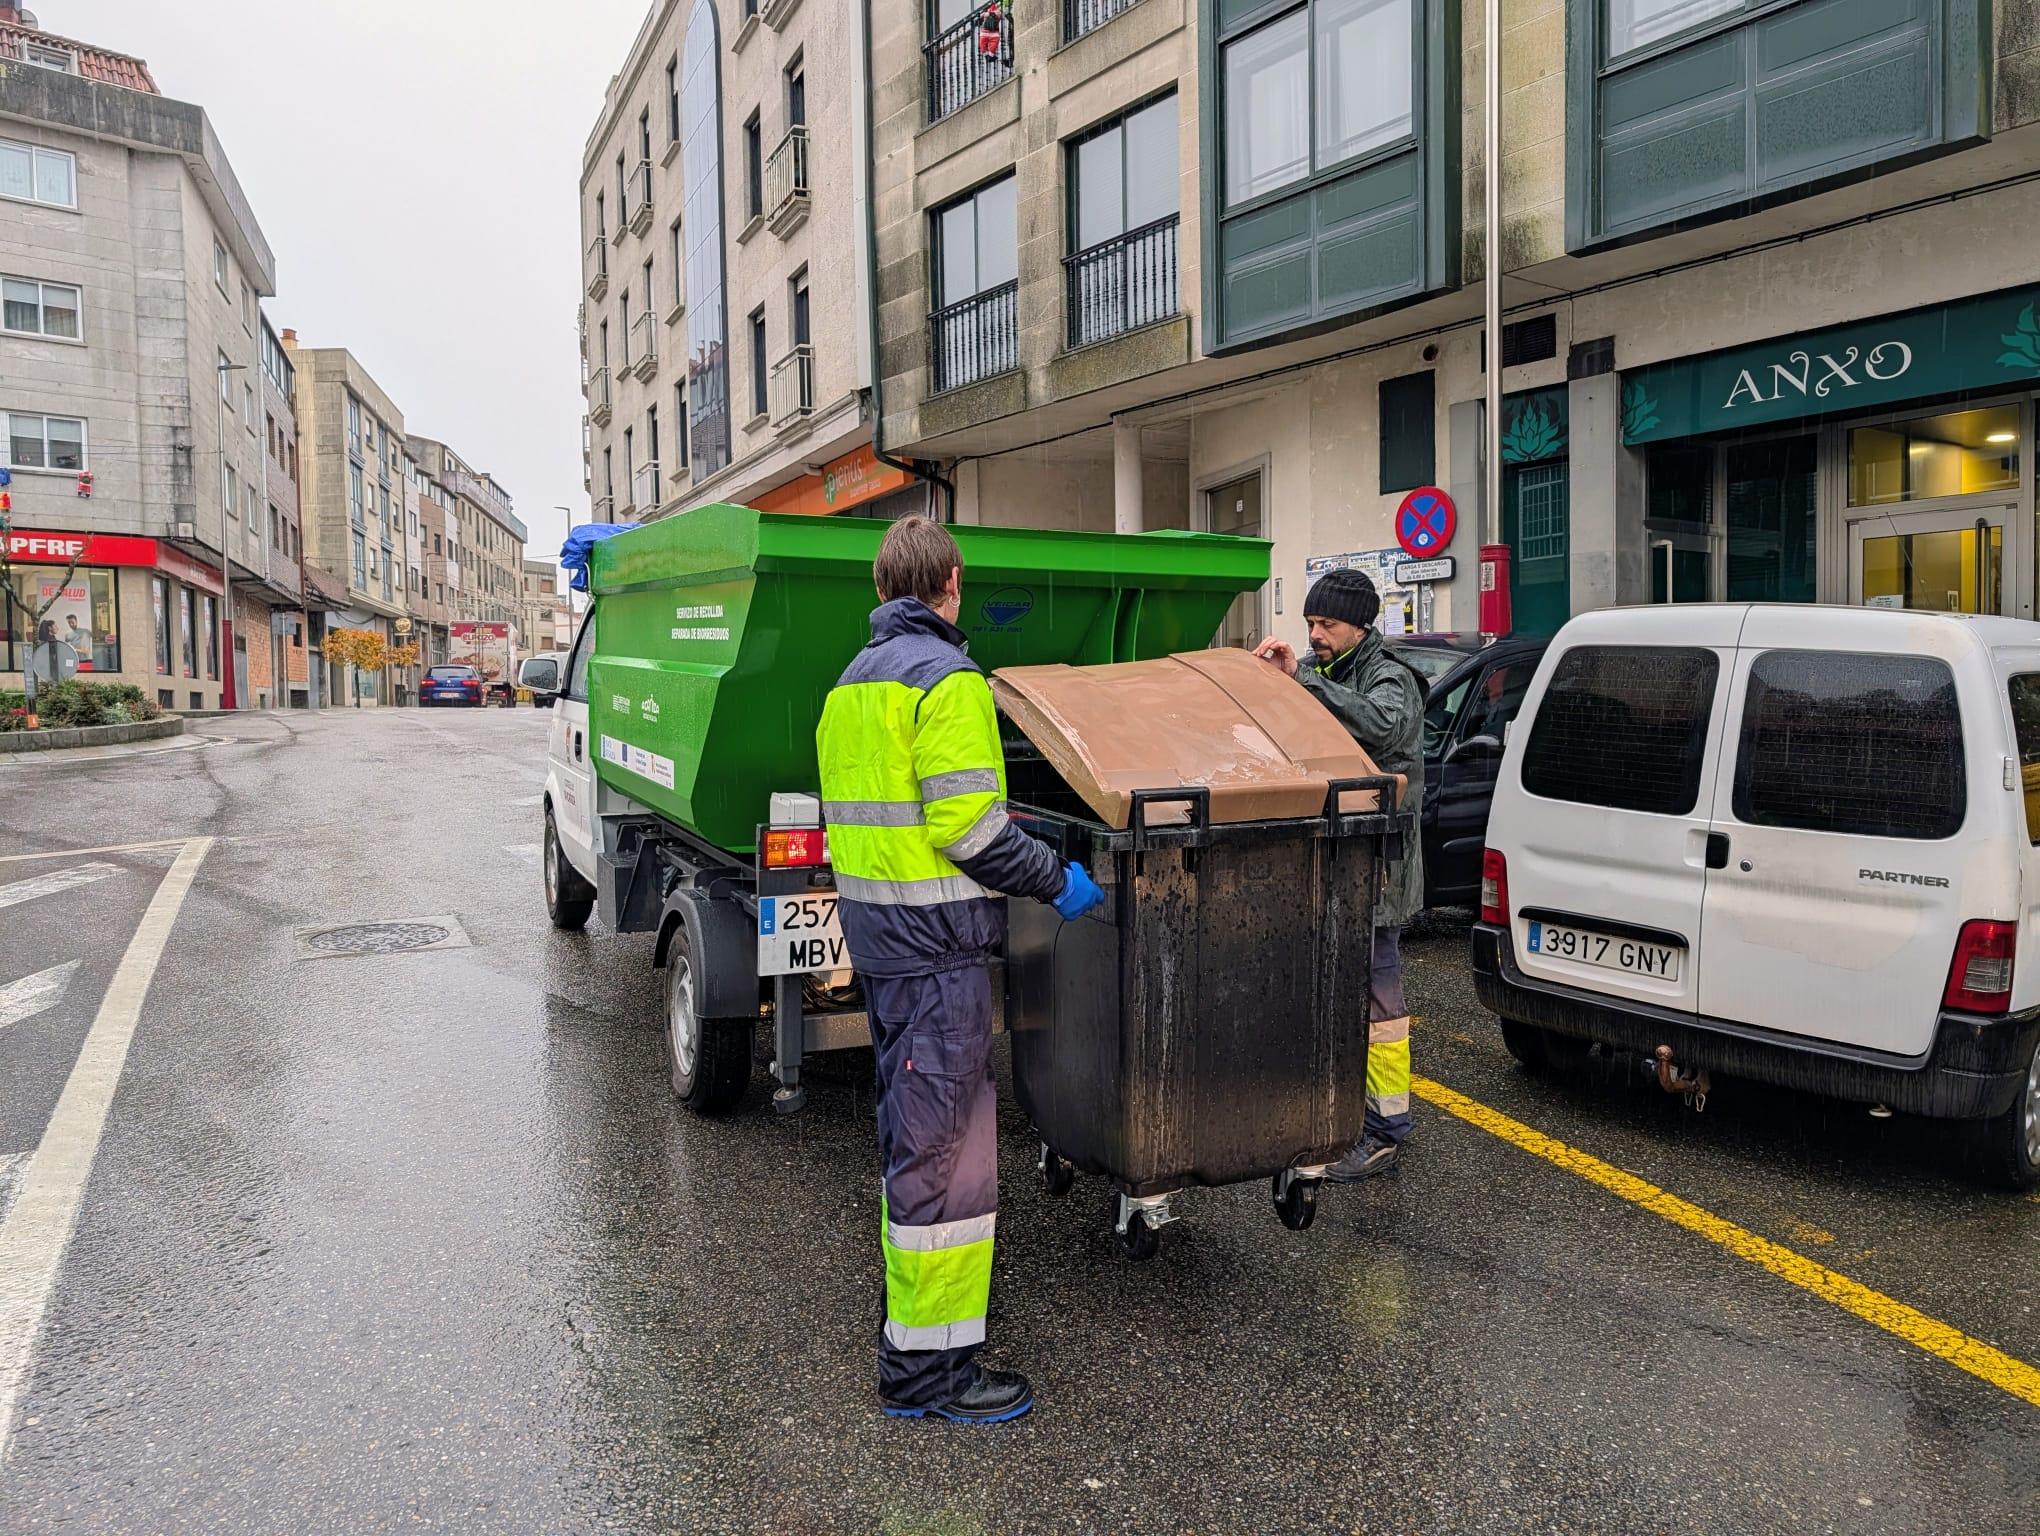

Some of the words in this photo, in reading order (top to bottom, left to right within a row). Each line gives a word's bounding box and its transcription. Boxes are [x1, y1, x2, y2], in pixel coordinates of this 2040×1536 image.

[1721, 341, 1912, 409] ANXO
[0, 536, 84, 556] PFRE
[56, 586, 86, 599] ALUD
[1859, 869, 1949, 888] PARTNER
[764, 920, 771, 929] E
[1531, 939, 1537, 947] E
[1545, 928, 1610, 962] 3917
[1619, 943, 1672, 975] GNY
[789, 937, 844, 969] MBV
